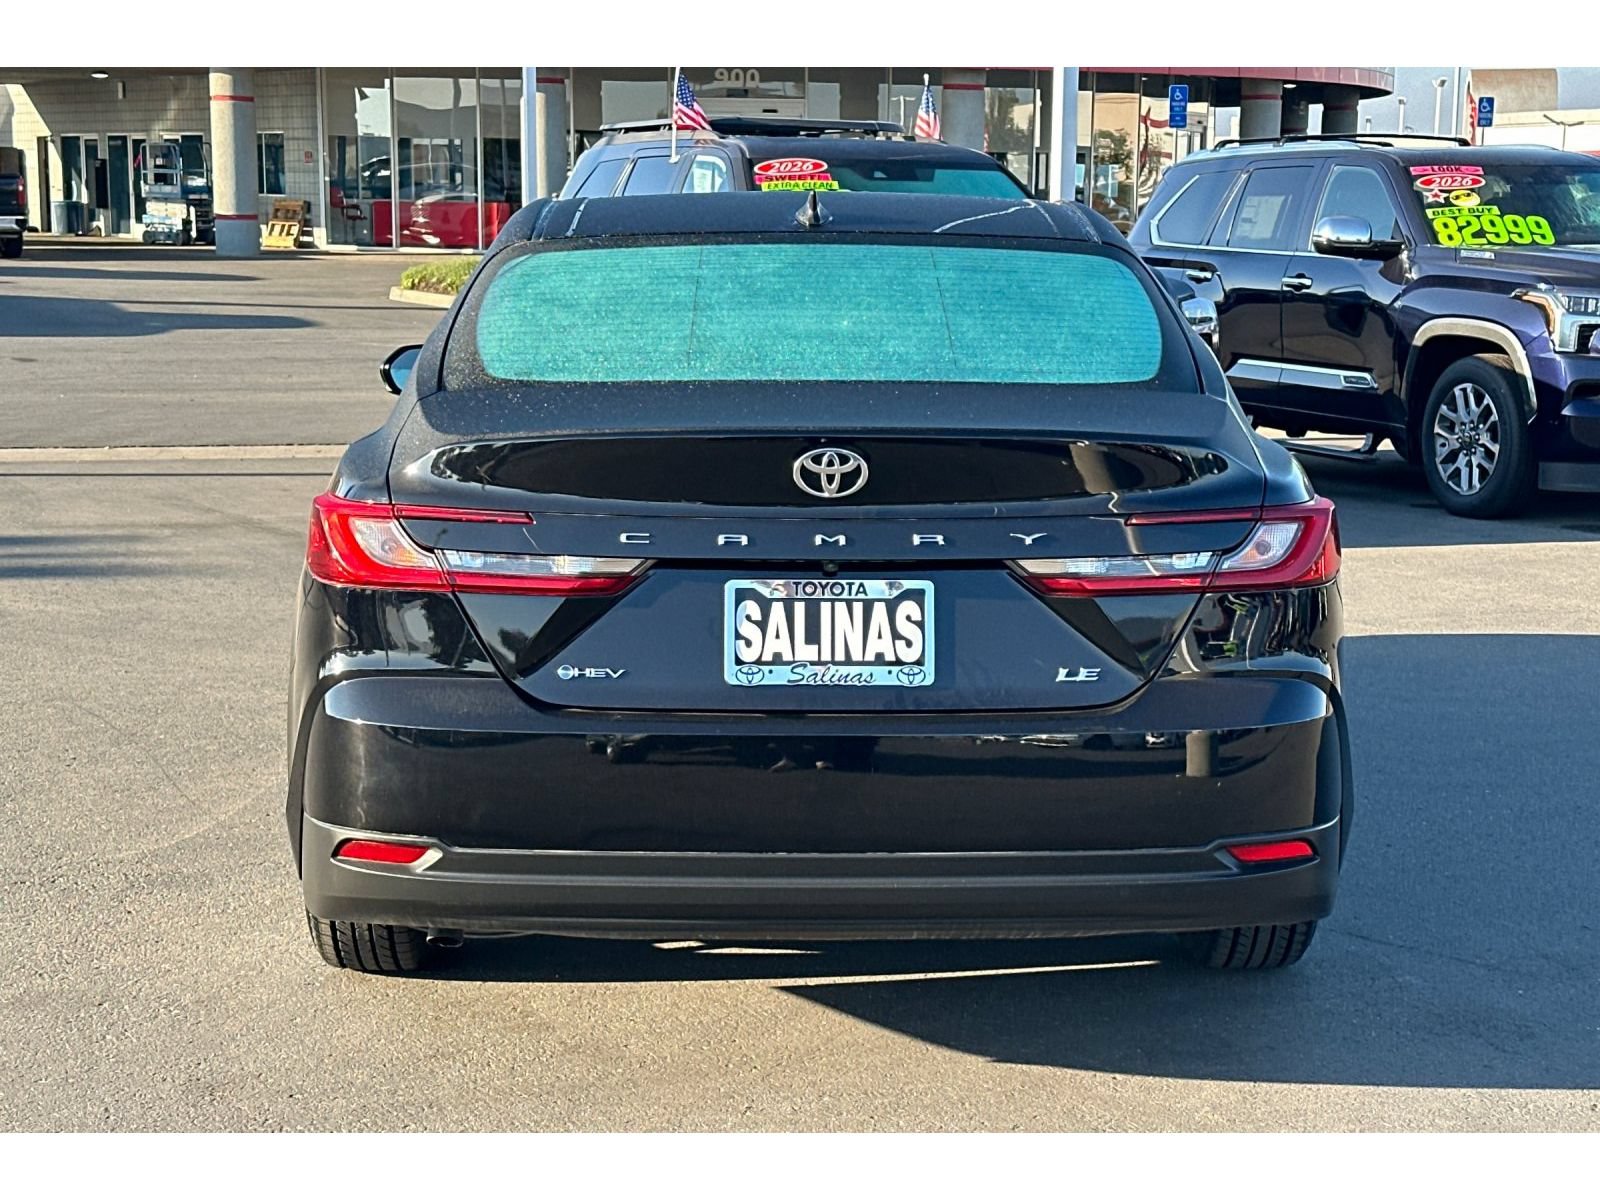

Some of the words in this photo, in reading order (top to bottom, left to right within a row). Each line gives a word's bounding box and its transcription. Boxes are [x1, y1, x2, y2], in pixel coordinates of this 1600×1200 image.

[767, 161, 814, 173] 2026
[767, 181, 800, 190] EXTRA
[801, 180, 834, 189] CLEAN
[1430, 176, 1474, 187] 2026
[1432, 207, 1463, 217] BEST
[1468, 206, 1495, 215] BUY
[1433, 215, 1555, 246] 82999
[619, 532, 1048, 547] CAMRY
[793, 581, 868, 597] TOYOTA
[735, 600, 924, 663] SALINAS
[574, 667, 626, 679] HEV
[787, 663, 876, 685] Salinas
[1055, 667, 1101, 682] LE
